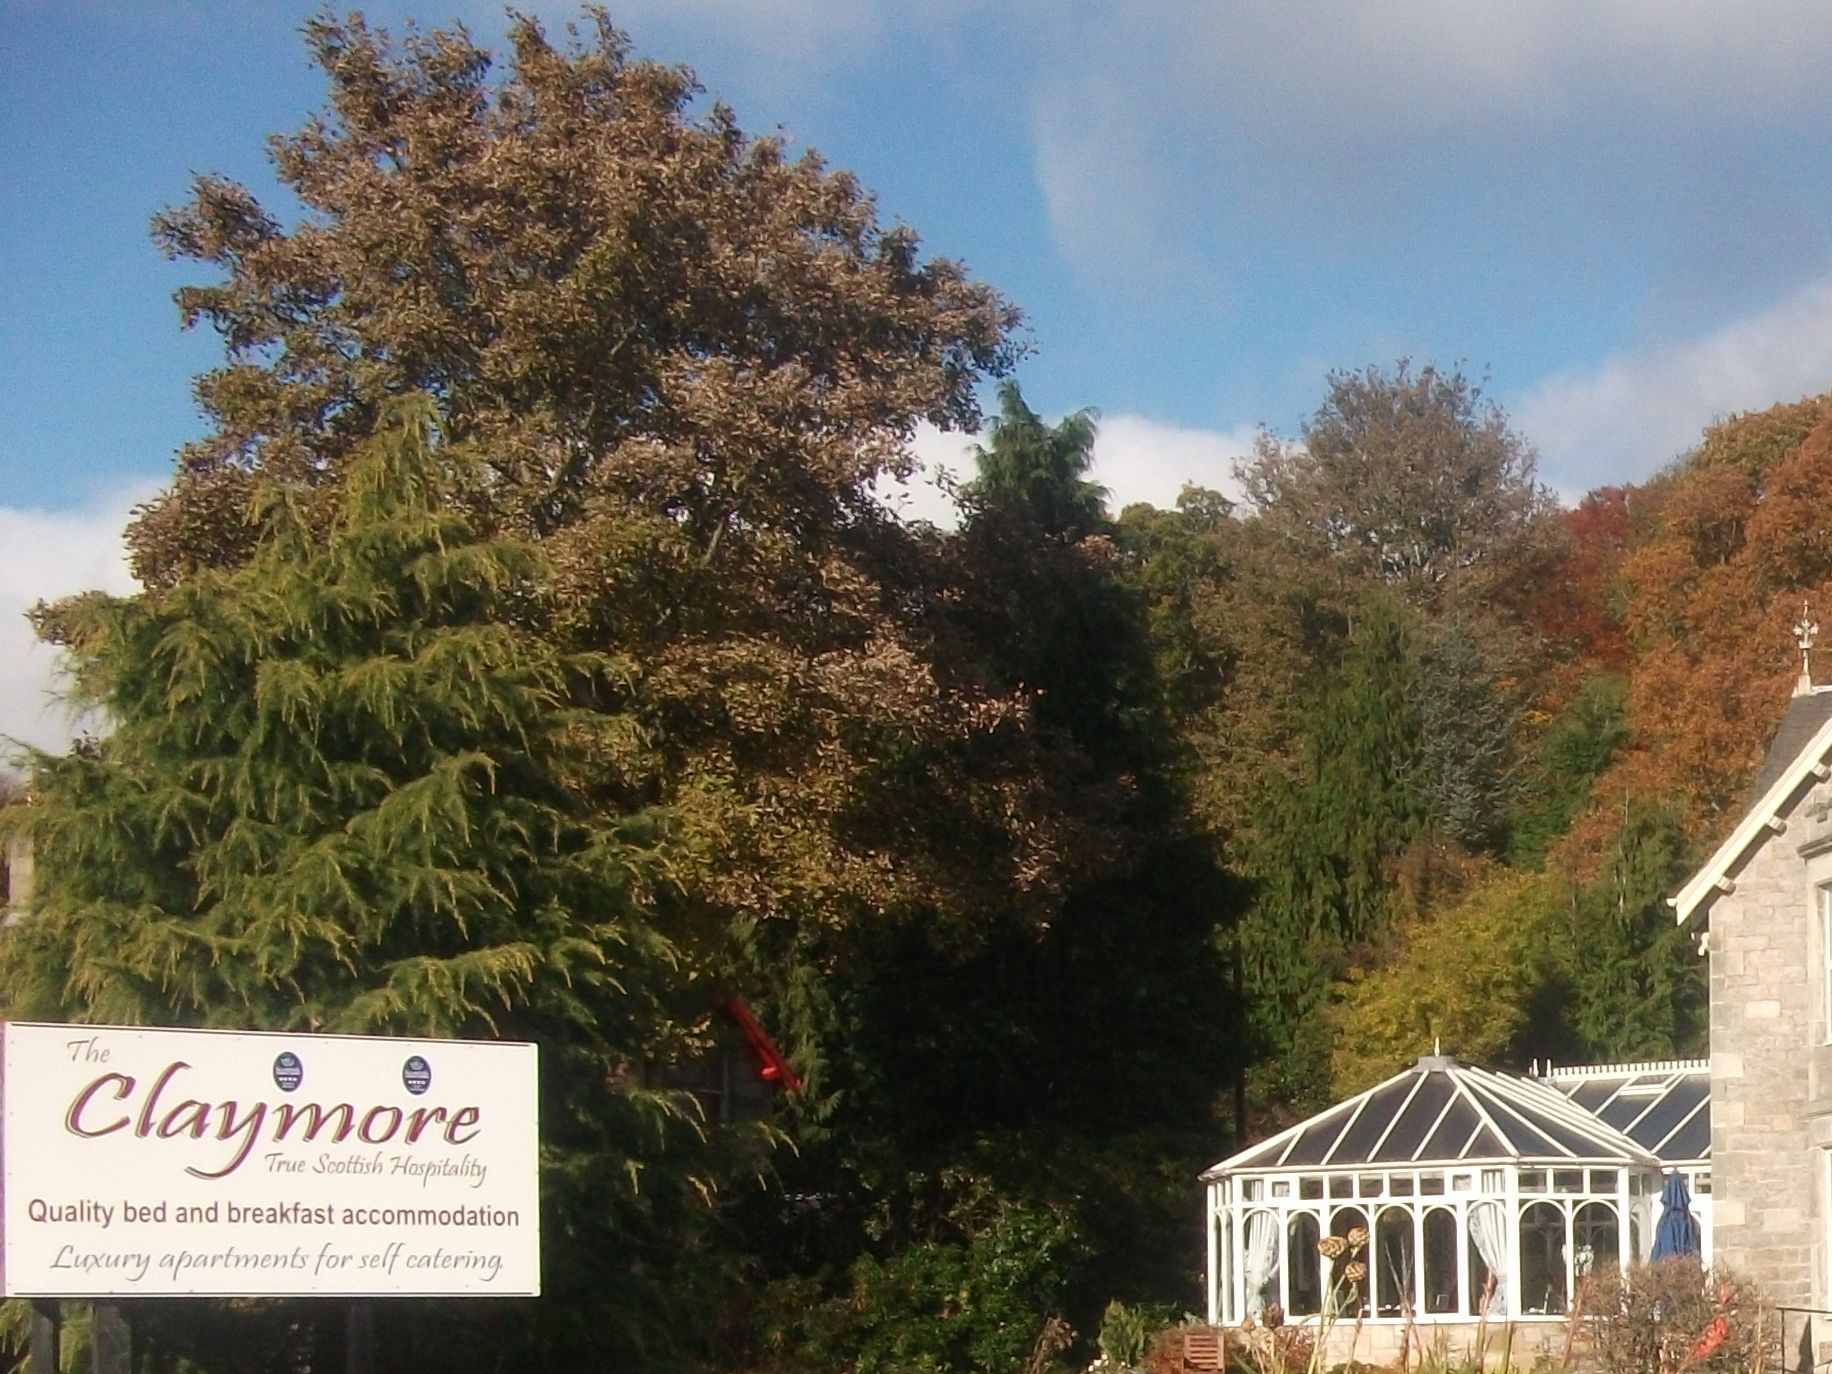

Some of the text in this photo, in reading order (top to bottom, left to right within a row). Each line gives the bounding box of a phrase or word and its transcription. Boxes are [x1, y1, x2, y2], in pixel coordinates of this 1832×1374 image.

[66, 1037, 111, 1064] The
[64, 1060, 482, 1180] Claymore
[264, 1151, 487, 1188] True Scottish Hospitality
[28, 1198, 519, 1229] Quality bed and breakfast accommodation
[50, 1243, 151, 1281] Luxury
[158, 1246, 307, 1281] apartments
[314, 1242, 353, 1276] for
[358, 1242, 405, 1275] self
